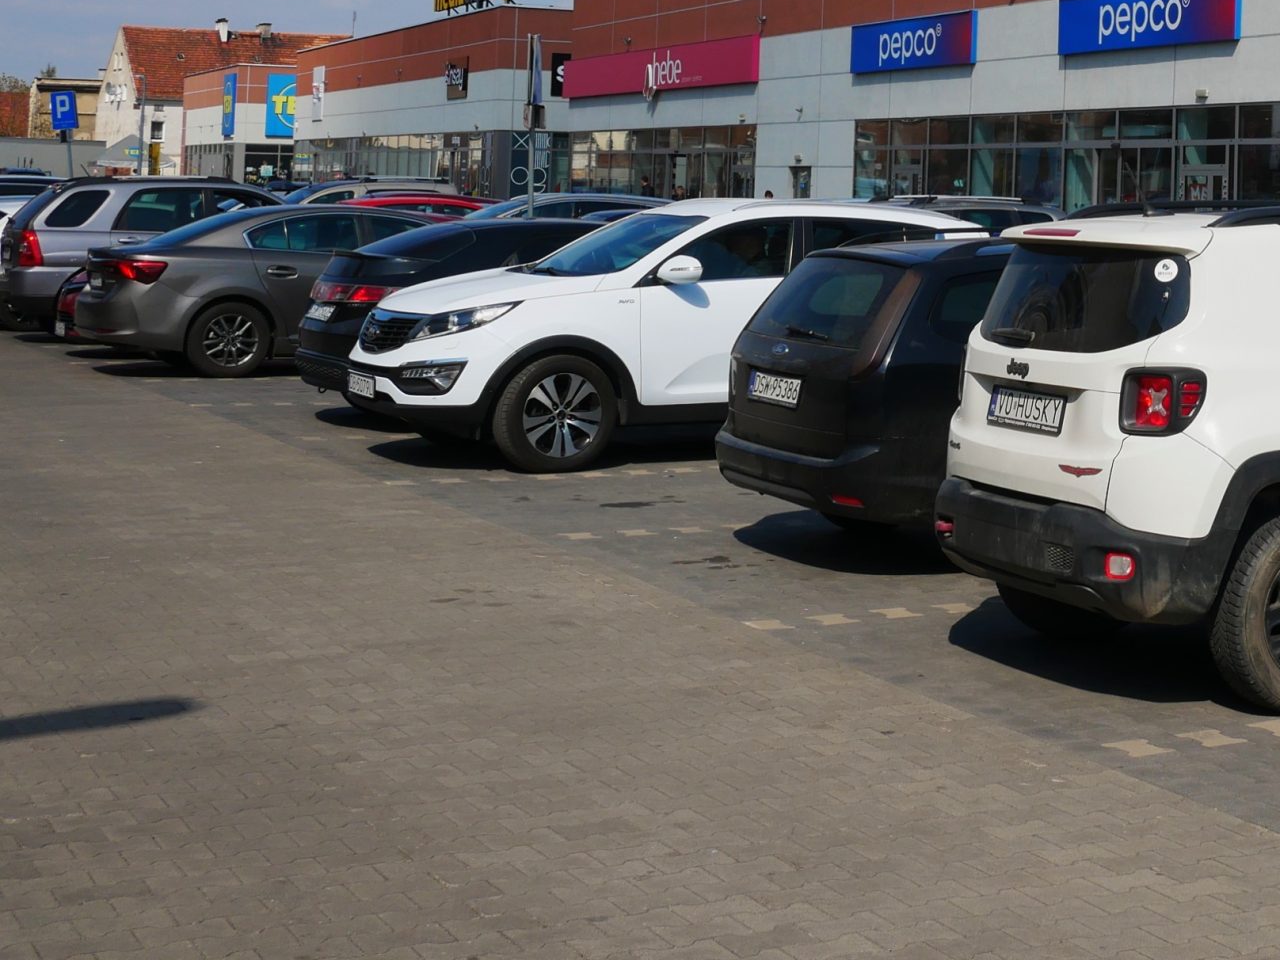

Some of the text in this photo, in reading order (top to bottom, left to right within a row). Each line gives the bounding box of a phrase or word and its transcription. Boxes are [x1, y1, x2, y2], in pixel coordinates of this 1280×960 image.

[878, 29, 936, 67] pepco
[652, 50, 682, 87] hebe
[55, 95, 70, 119] P
[753, 374, 800, 401] DSW 95386
[1015, 394, 1062, 425] HUSKY
